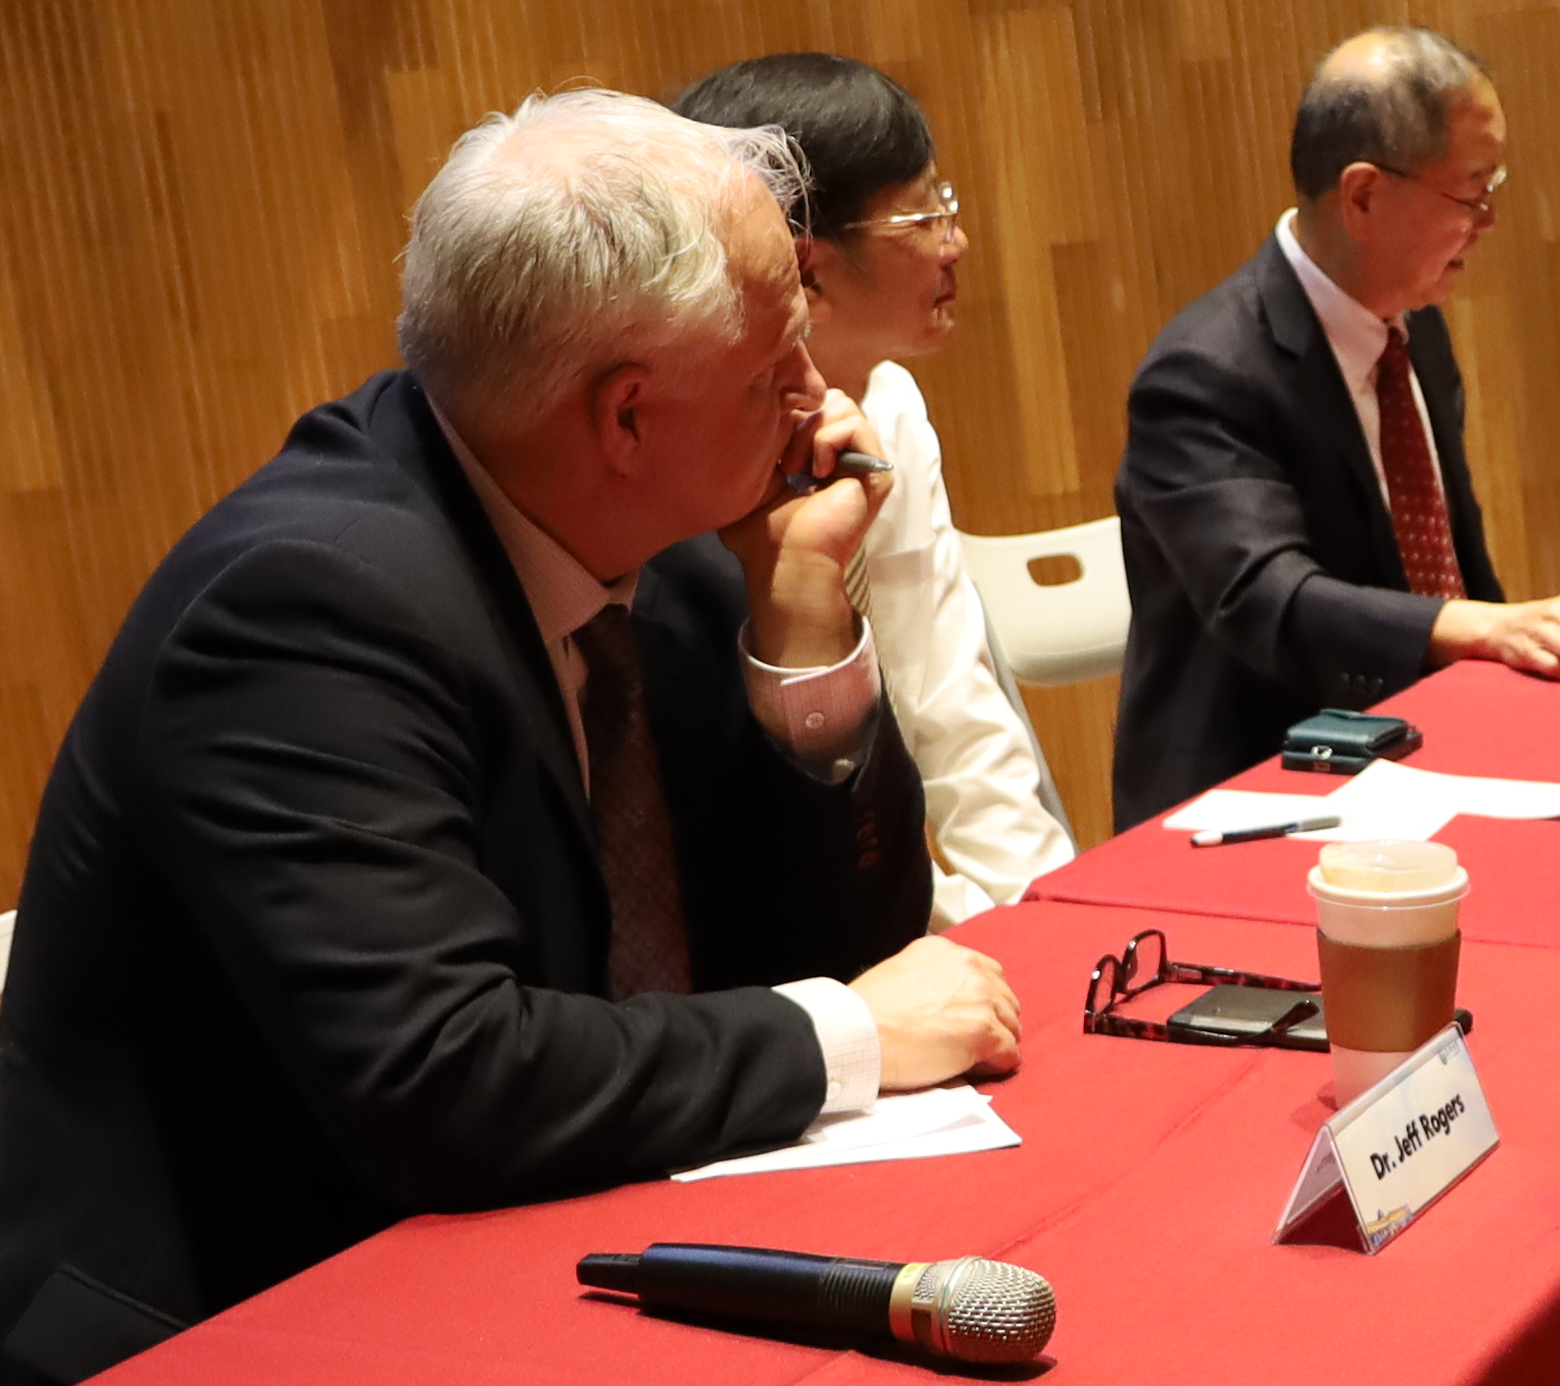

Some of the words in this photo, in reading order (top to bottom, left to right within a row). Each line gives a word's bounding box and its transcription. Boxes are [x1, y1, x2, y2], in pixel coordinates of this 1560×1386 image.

[1370, 1151, 1396, 1181] Dr.
[1396, 1124, 1423, 1163] Jeff
[1420, 1093, 1465, 1141] Rogers
